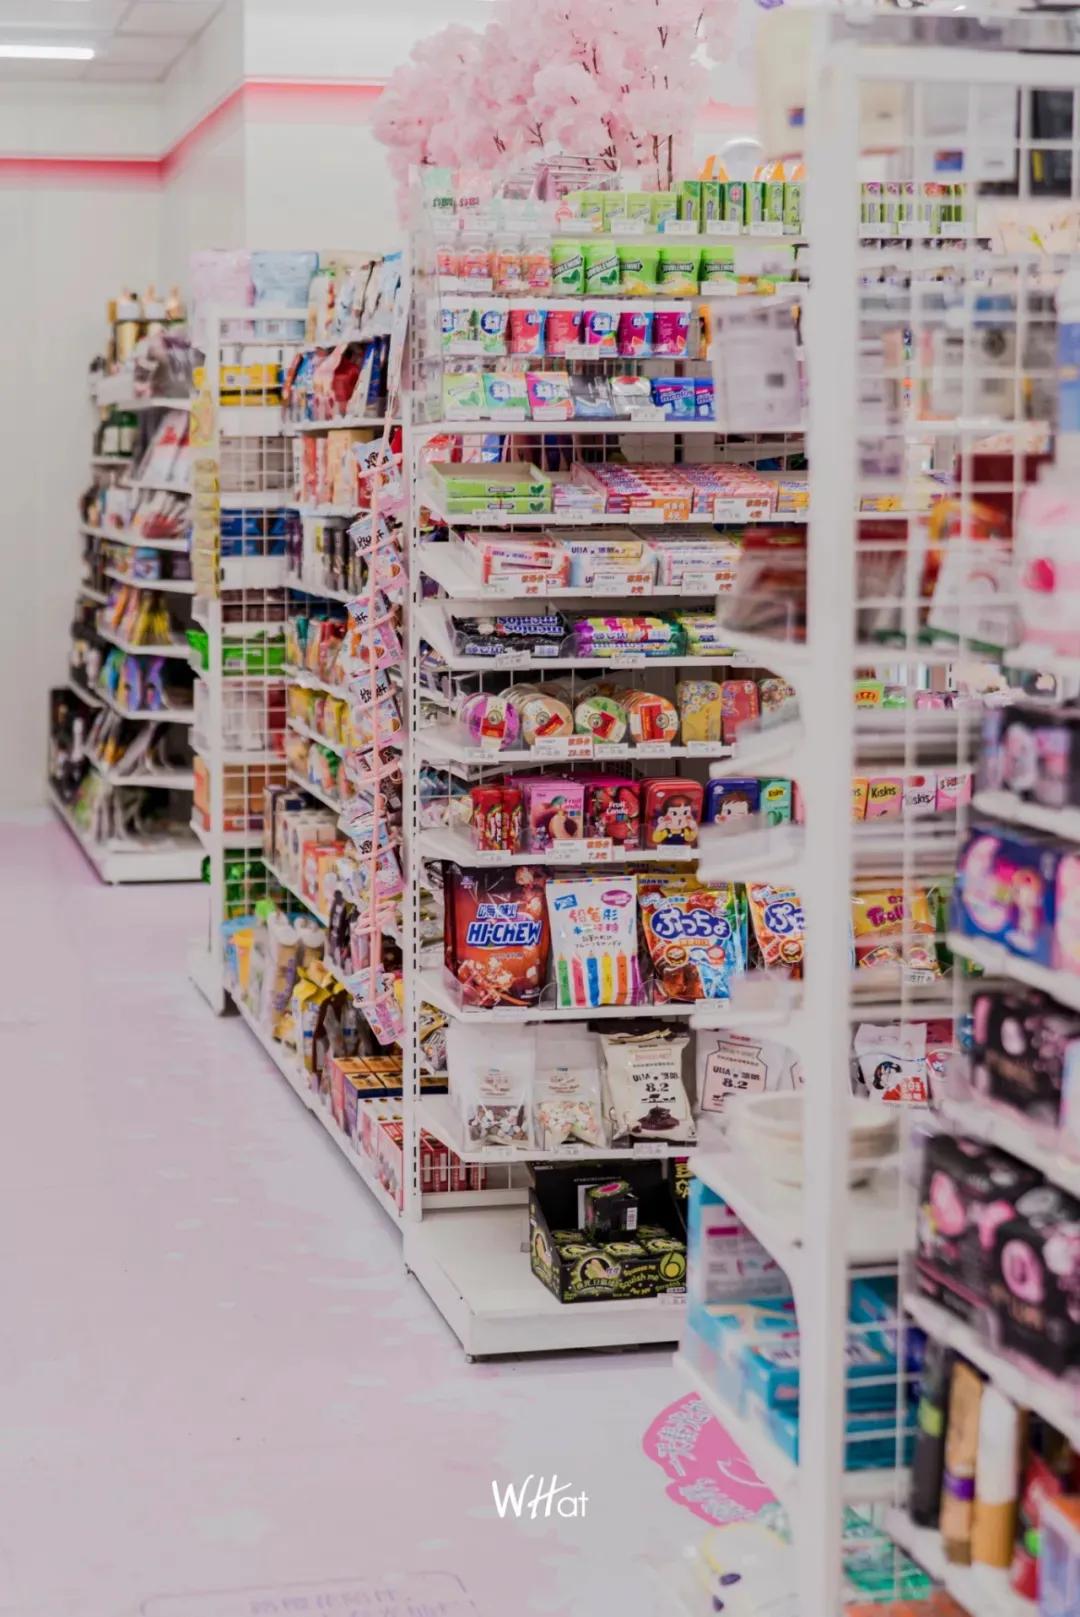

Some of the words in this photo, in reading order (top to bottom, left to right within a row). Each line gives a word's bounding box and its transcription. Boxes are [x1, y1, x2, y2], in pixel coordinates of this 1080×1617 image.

[504, 624, 564, 635] mentos
[656, 908, 728, 937] ぷっちょ
[645, 1082, 669, 1093] 8.2
[722, 1078, 748, 1090] 8.2
